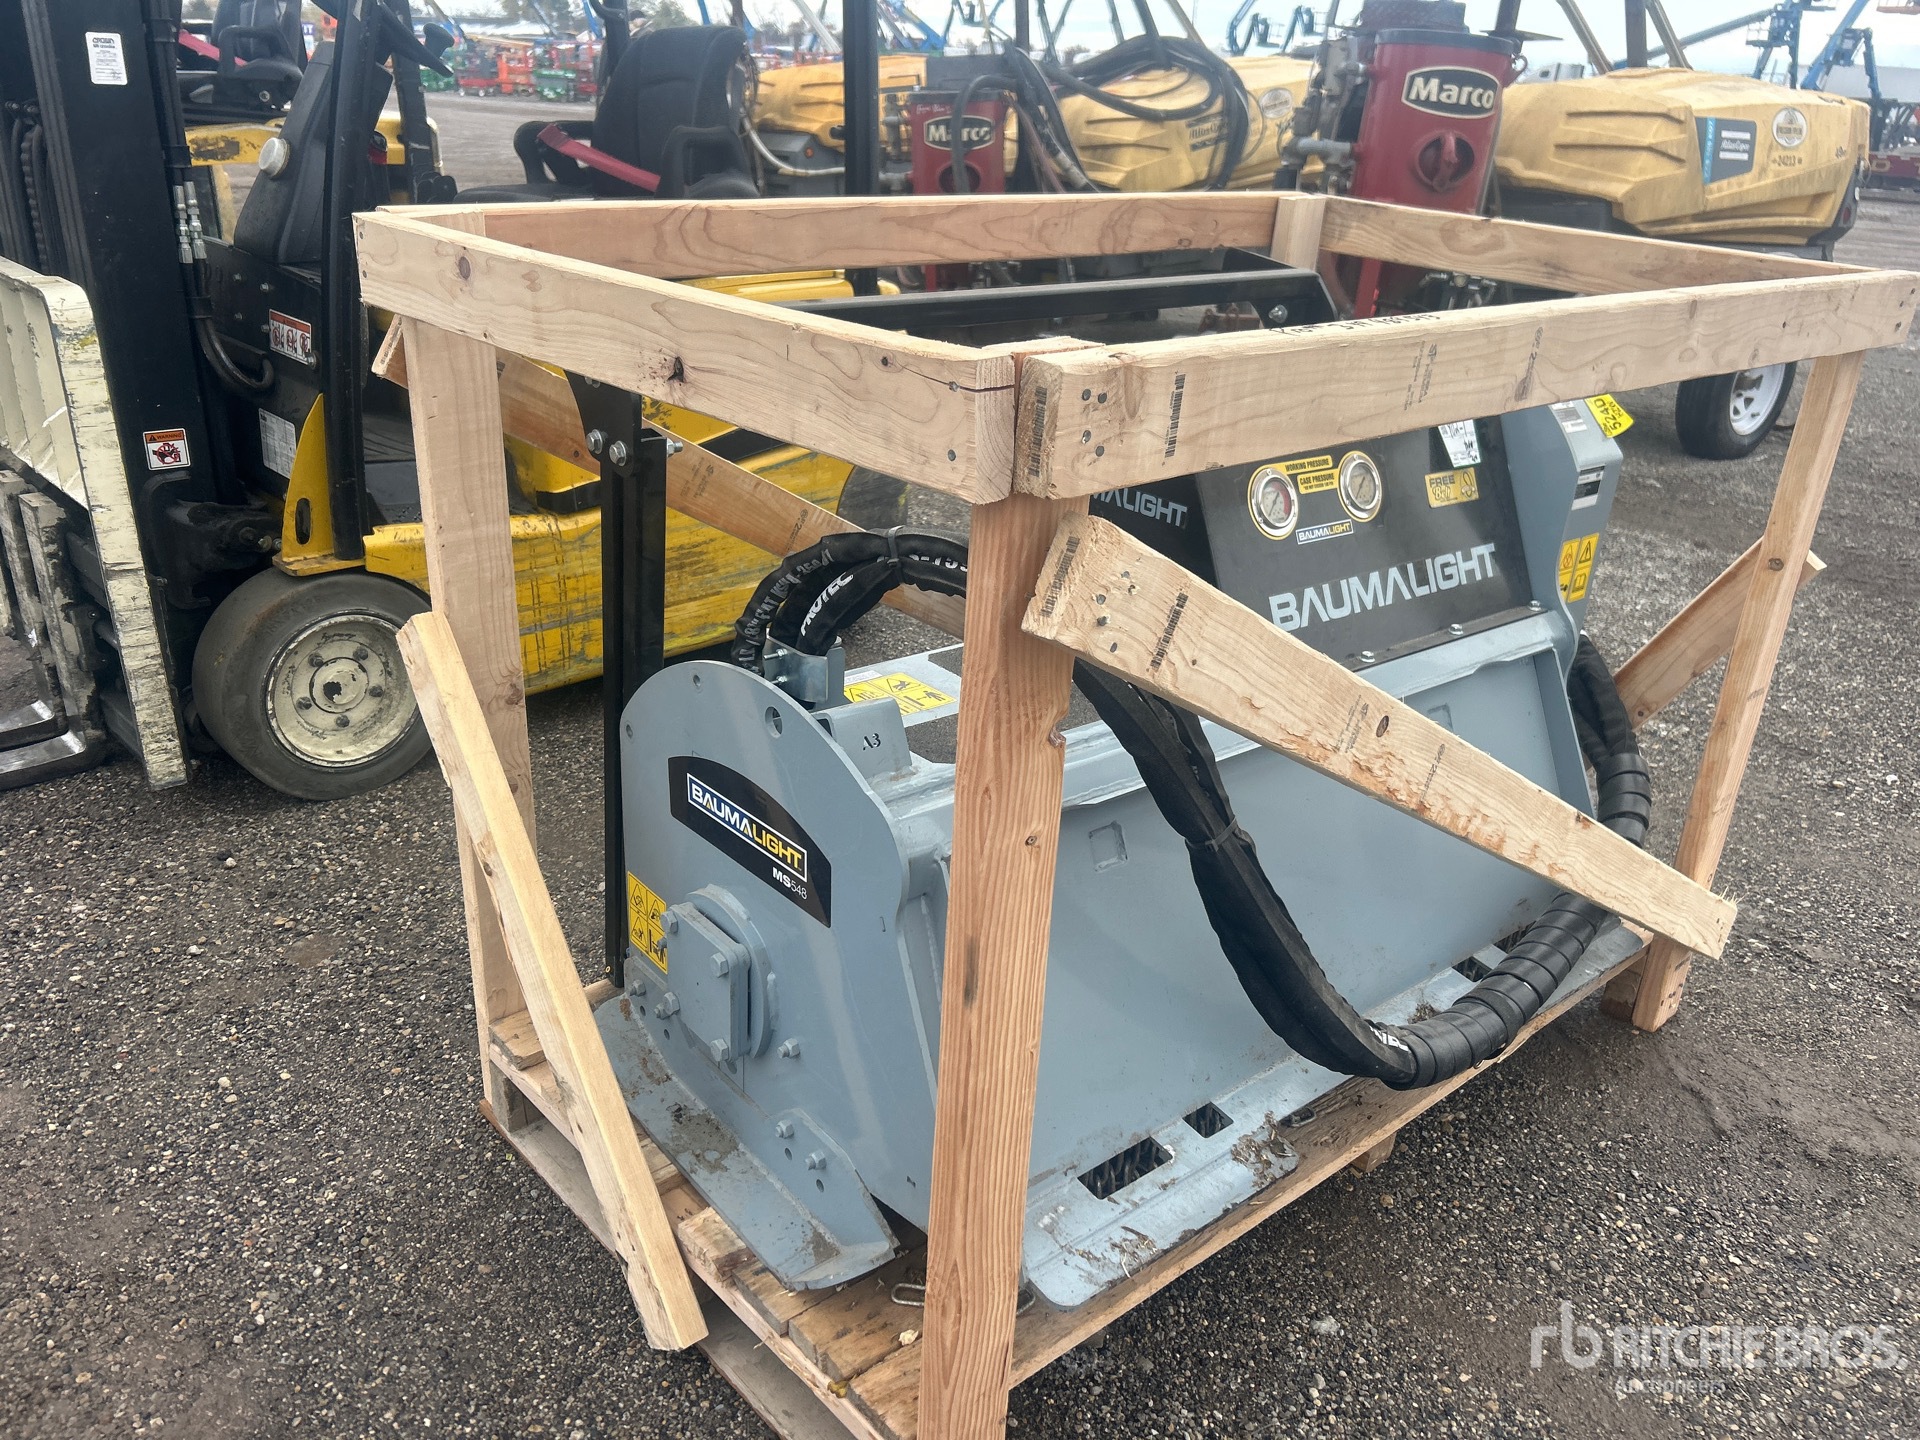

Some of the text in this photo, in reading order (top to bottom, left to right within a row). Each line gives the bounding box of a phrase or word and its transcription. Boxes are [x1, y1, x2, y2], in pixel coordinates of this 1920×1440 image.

[1408, 77, 1495, 109] Marco
[928, 124, 992, 142] Mrco
[1594, 398, 1622, 431] 524D
[156, 432, 182, 440] WARNING
[1285, 458, 1330, 472] WORKING PRESSURE
[1299, 473, 1335, 486] CASE PRESSURE
[1429, 474, 1456, 488] FREE
[1298, 523, 1351, 541] BAUMALIGHT
[1268, 542, 1497, 632] BAUMALIGHT
[862, 732, 882, 751] A3
[691, 782, 802, 869] BAUMALIGHT
[772, 866, 808, 900] MS548
